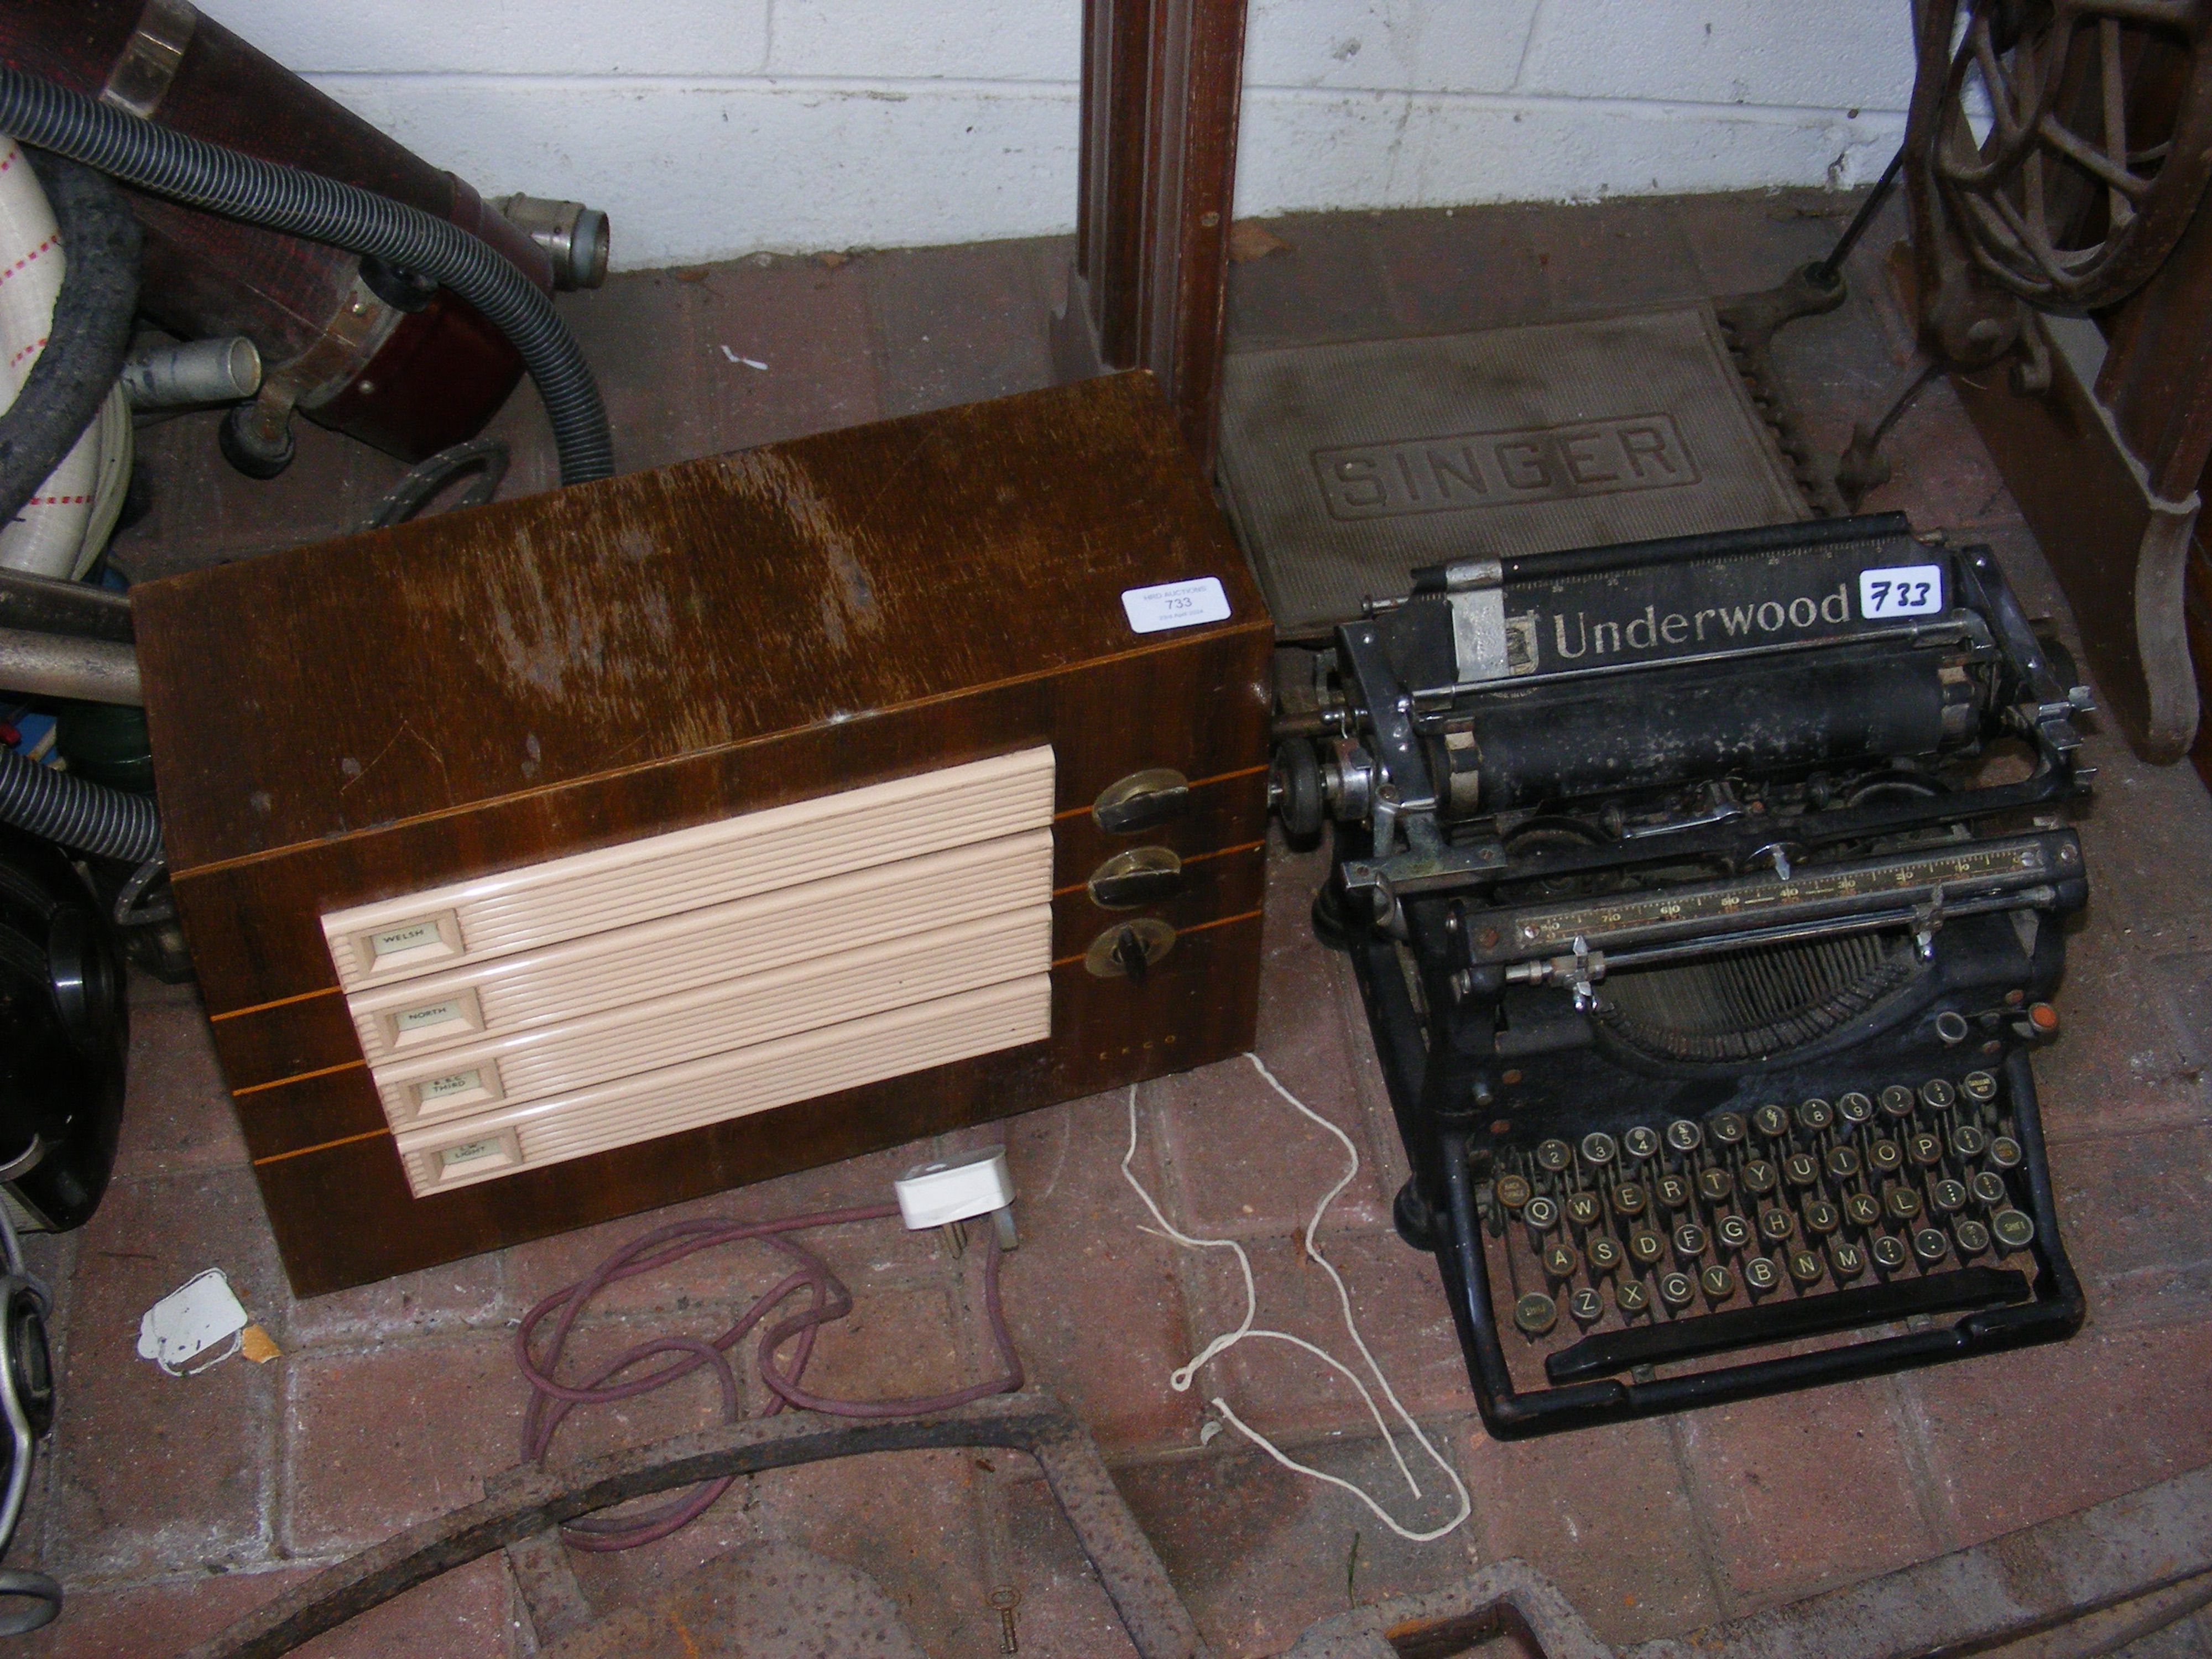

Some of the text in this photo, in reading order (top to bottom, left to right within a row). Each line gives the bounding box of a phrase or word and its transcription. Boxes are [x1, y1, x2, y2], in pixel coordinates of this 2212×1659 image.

[1333, 427, 1677, 507] SINGER
[1165, 597, 1192, 609] 733
[1554, 583, 1850, 658] Underwood
[1871, 581, 1931, 612] 733
[384, 929, 424, 943] WELSH
[409, 1007, 446, 1020] NORTH
[432, 1080, 466, 1092] THIRD
[1550, 1152, 1559, 1163] 2
[1595, 1146, 1605, 1157] 3
[1639, 1140, 1648, 1150] 4
[1681, 1134, 1692, 1145] 5
[1726, 1124, 1735, 1135] 6
[1813, 1110, 1824, 1121] 8
[1854, 1105, 1864, 1117] 9
[1531, 1139, 1933, 1220] Q W E R T Y U I O P
[1556, 1194, 1913, 1265] A S D F G H J K L
[1579, 1293, 1595, 1311] Z
[1624, 1286, 1642, 1303] X
[1668, 1279, 1687, 1296] C
[1710, 1271, 1723, 1287] V
[1755, 1264, 1771, 1281] B
[1798, 1256, 1815, 1273] N
[1838, 1249, 1857, 1266] M
